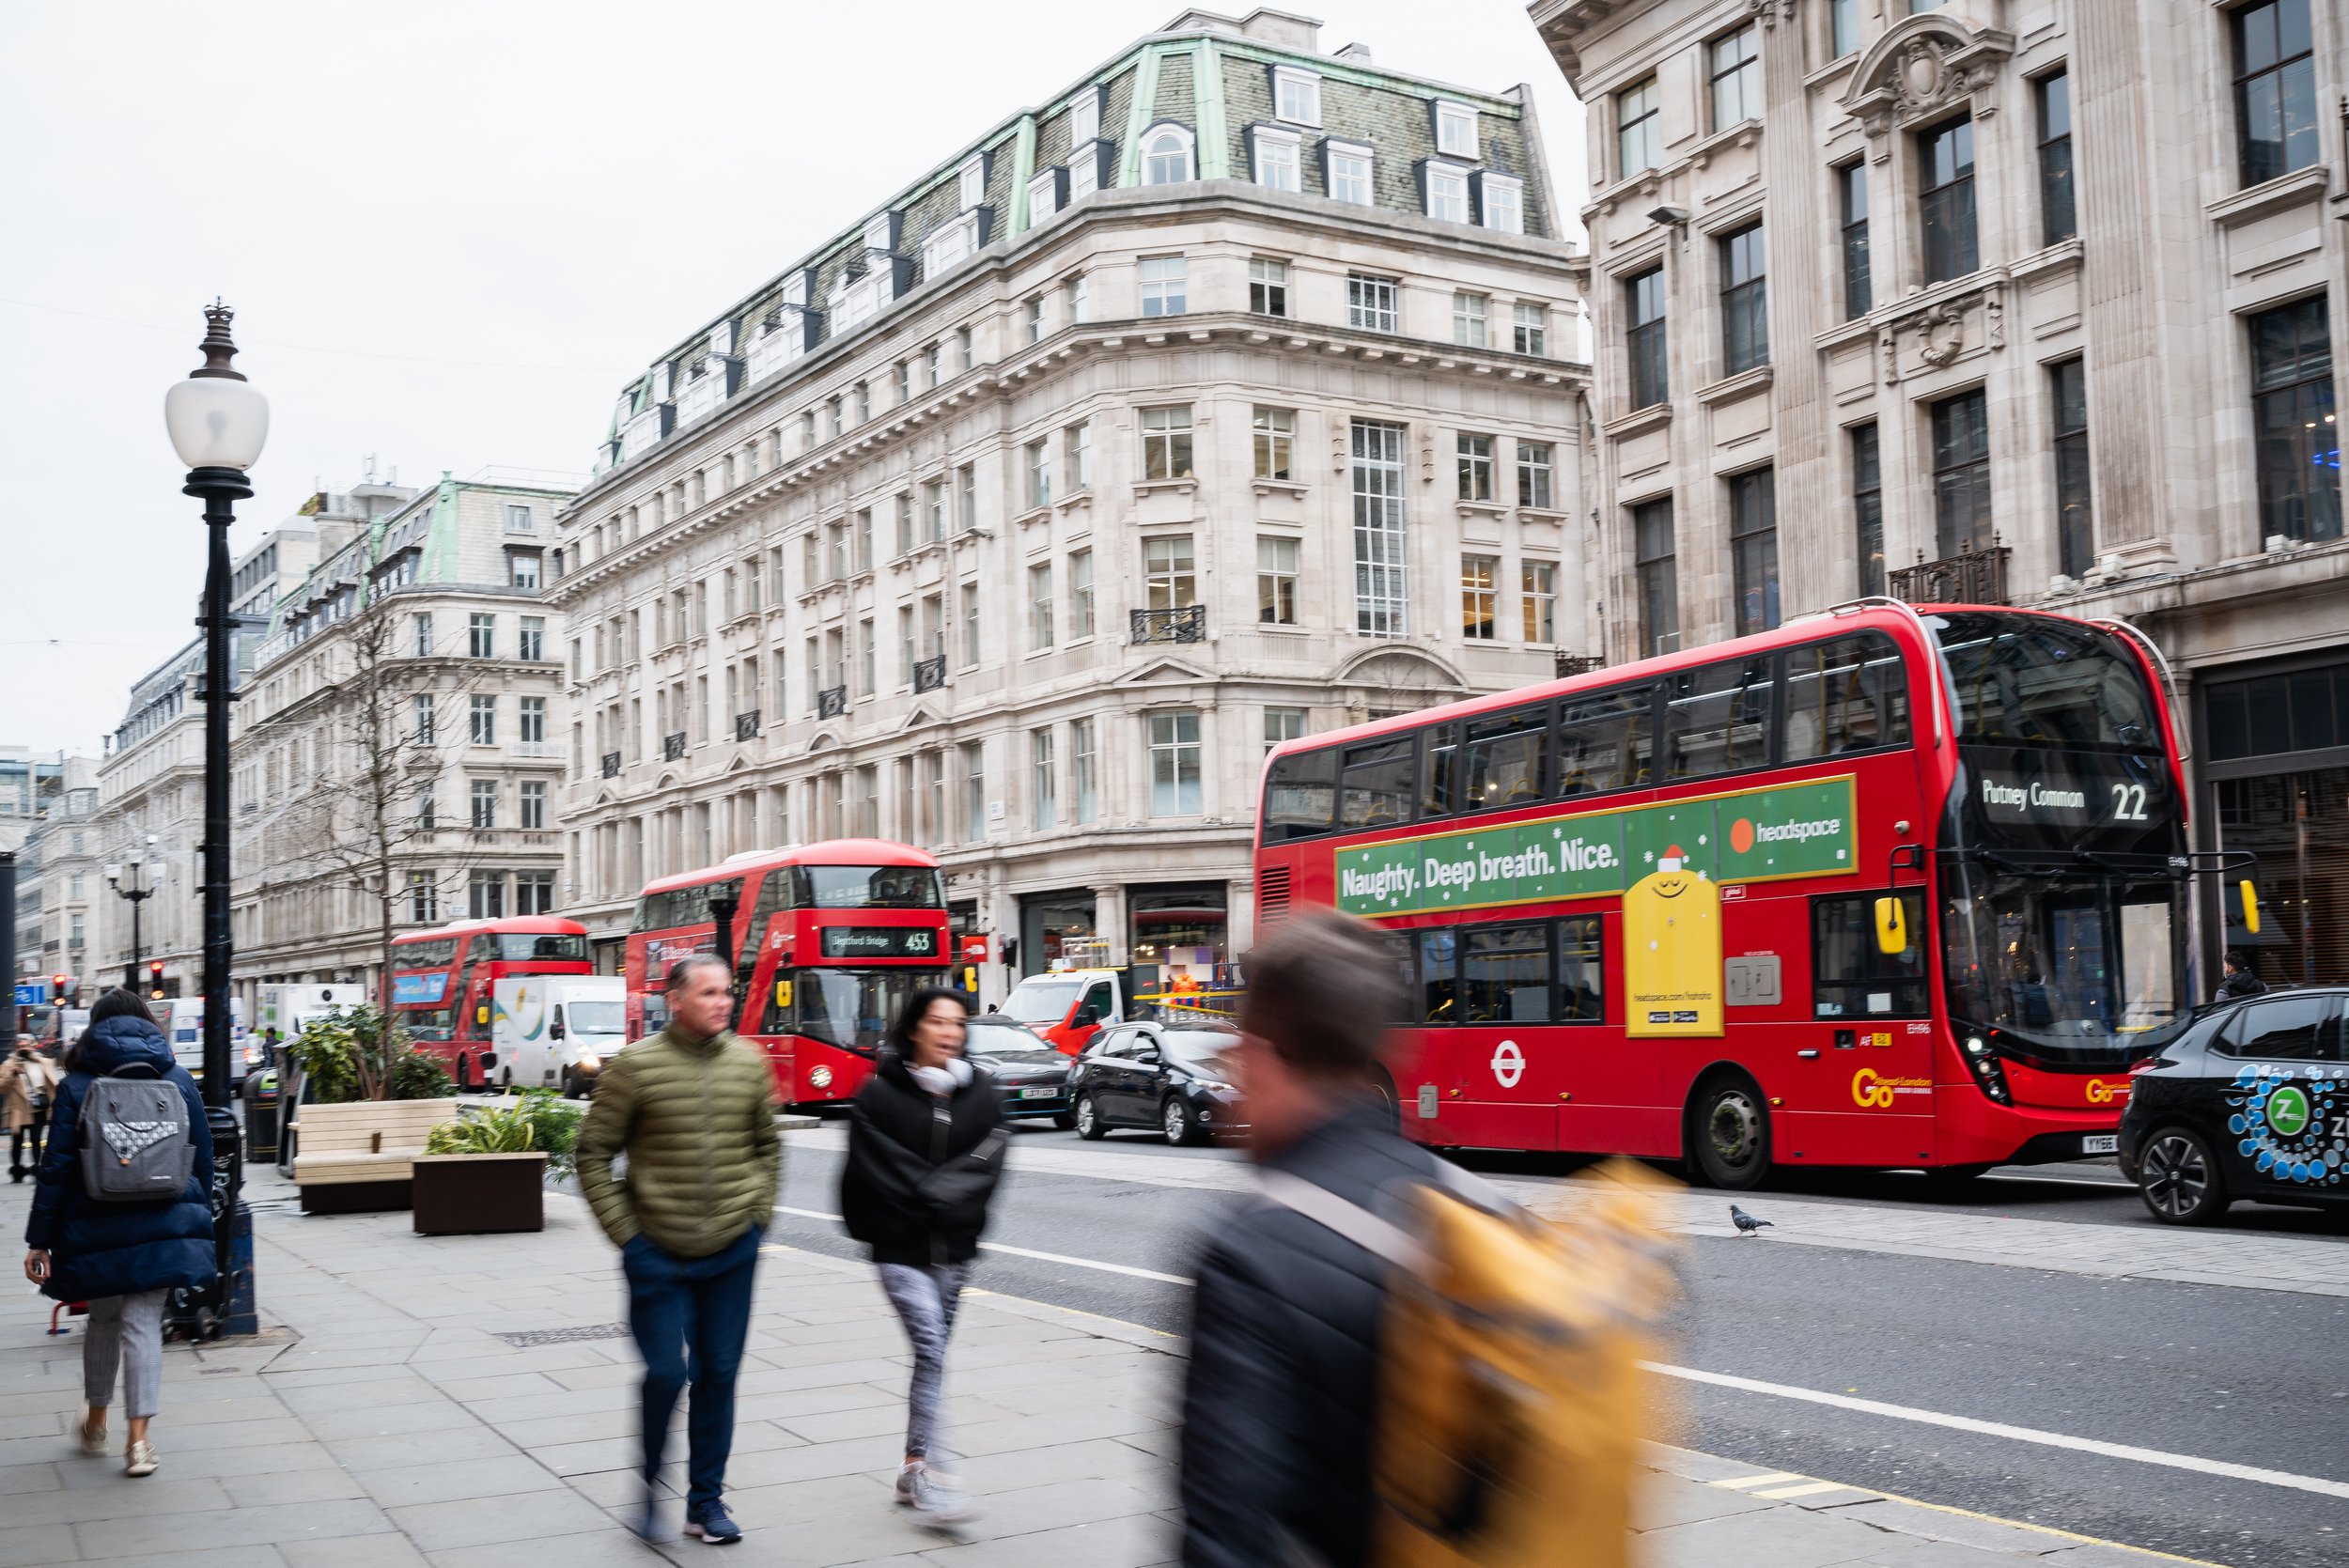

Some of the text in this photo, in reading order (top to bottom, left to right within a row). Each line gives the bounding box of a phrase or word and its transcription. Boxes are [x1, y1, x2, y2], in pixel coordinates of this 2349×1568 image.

[1983, 780, 2085, 812] Putney Common
[2111, 784, 2148, 820] 22
[1756, 818, 1841, 843] headspace
[1342, 837, 1619, 900] Naughty. Deep breath. Nice.
[905, 933, 930, 951] 453
[1851, 1067, 1894, 1108] Go
[2086, 1079, 2113, 1103] Go
